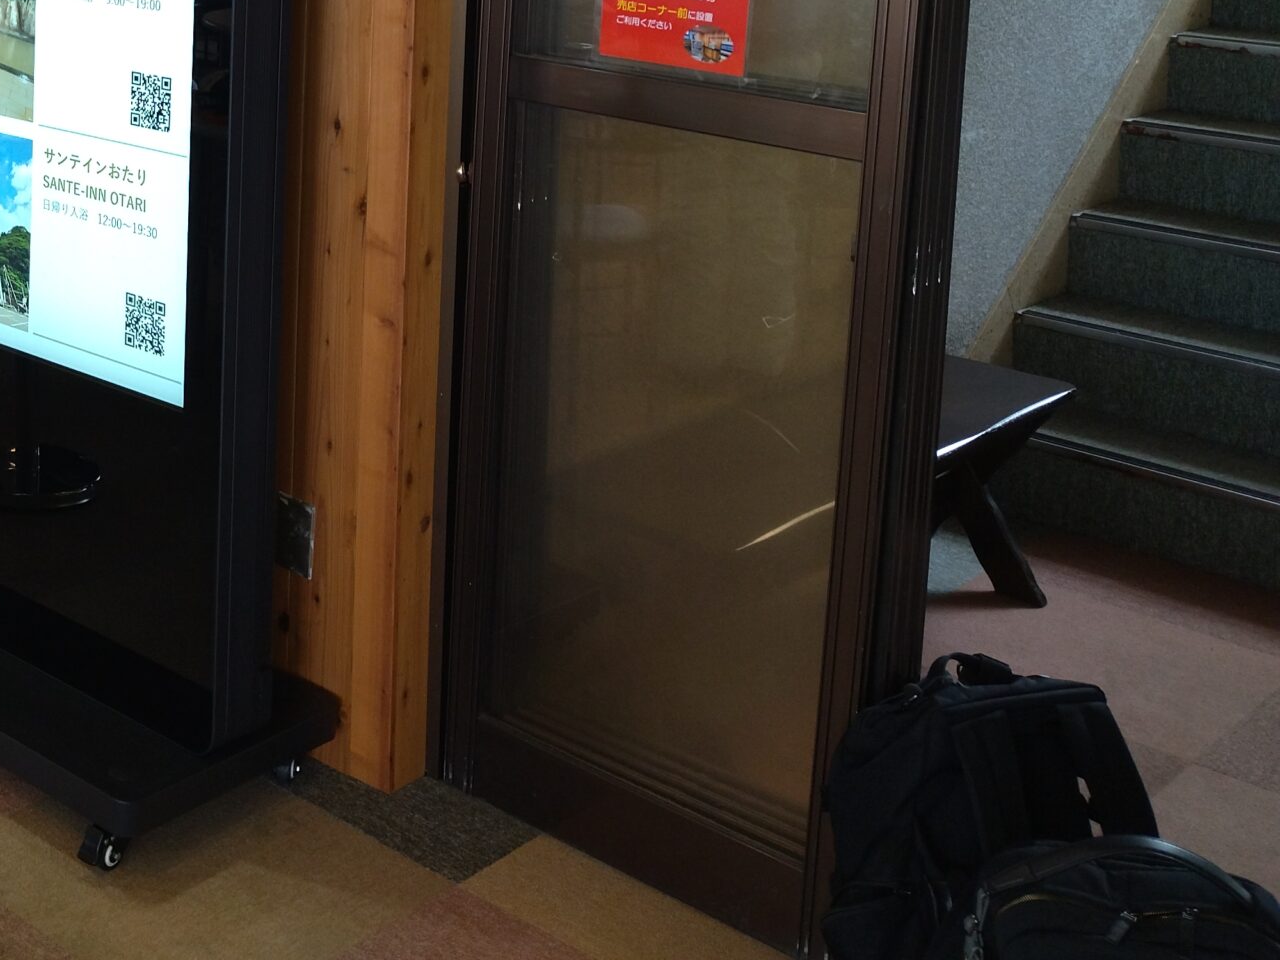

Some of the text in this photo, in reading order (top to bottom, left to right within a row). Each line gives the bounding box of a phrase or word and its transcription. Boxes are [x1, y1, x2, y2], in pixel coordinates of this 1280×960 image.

[617, 15, 672, 30] ご利用ください
[44, 148, 145, 186] サンテインおたり
[43, 175, 146, 212] SANTE-INN OTARI
